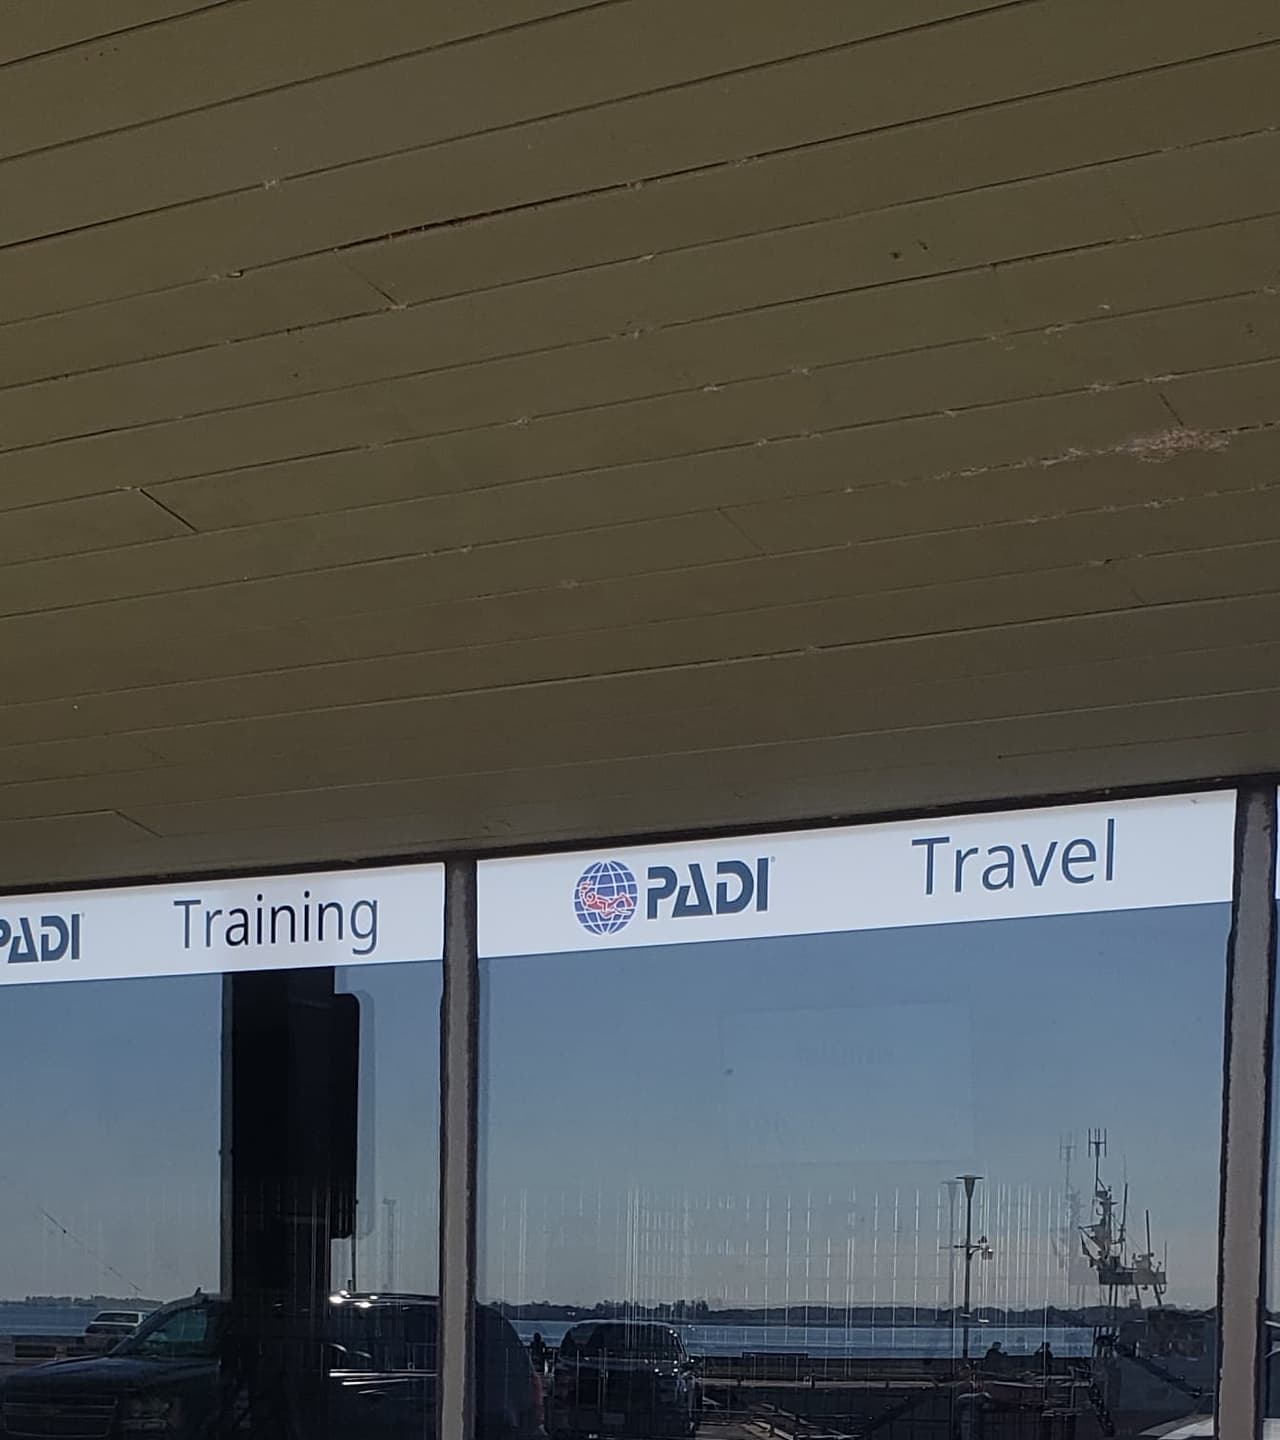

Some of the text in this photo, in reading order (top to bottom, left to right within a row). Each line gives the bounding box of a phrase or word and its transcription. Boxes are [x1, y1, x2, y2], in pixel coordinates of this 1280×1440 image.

[647, 857, 770, 920] PADI
[912, 818, 1116, 896] Travel
[173, 890, 379, 955] Training
